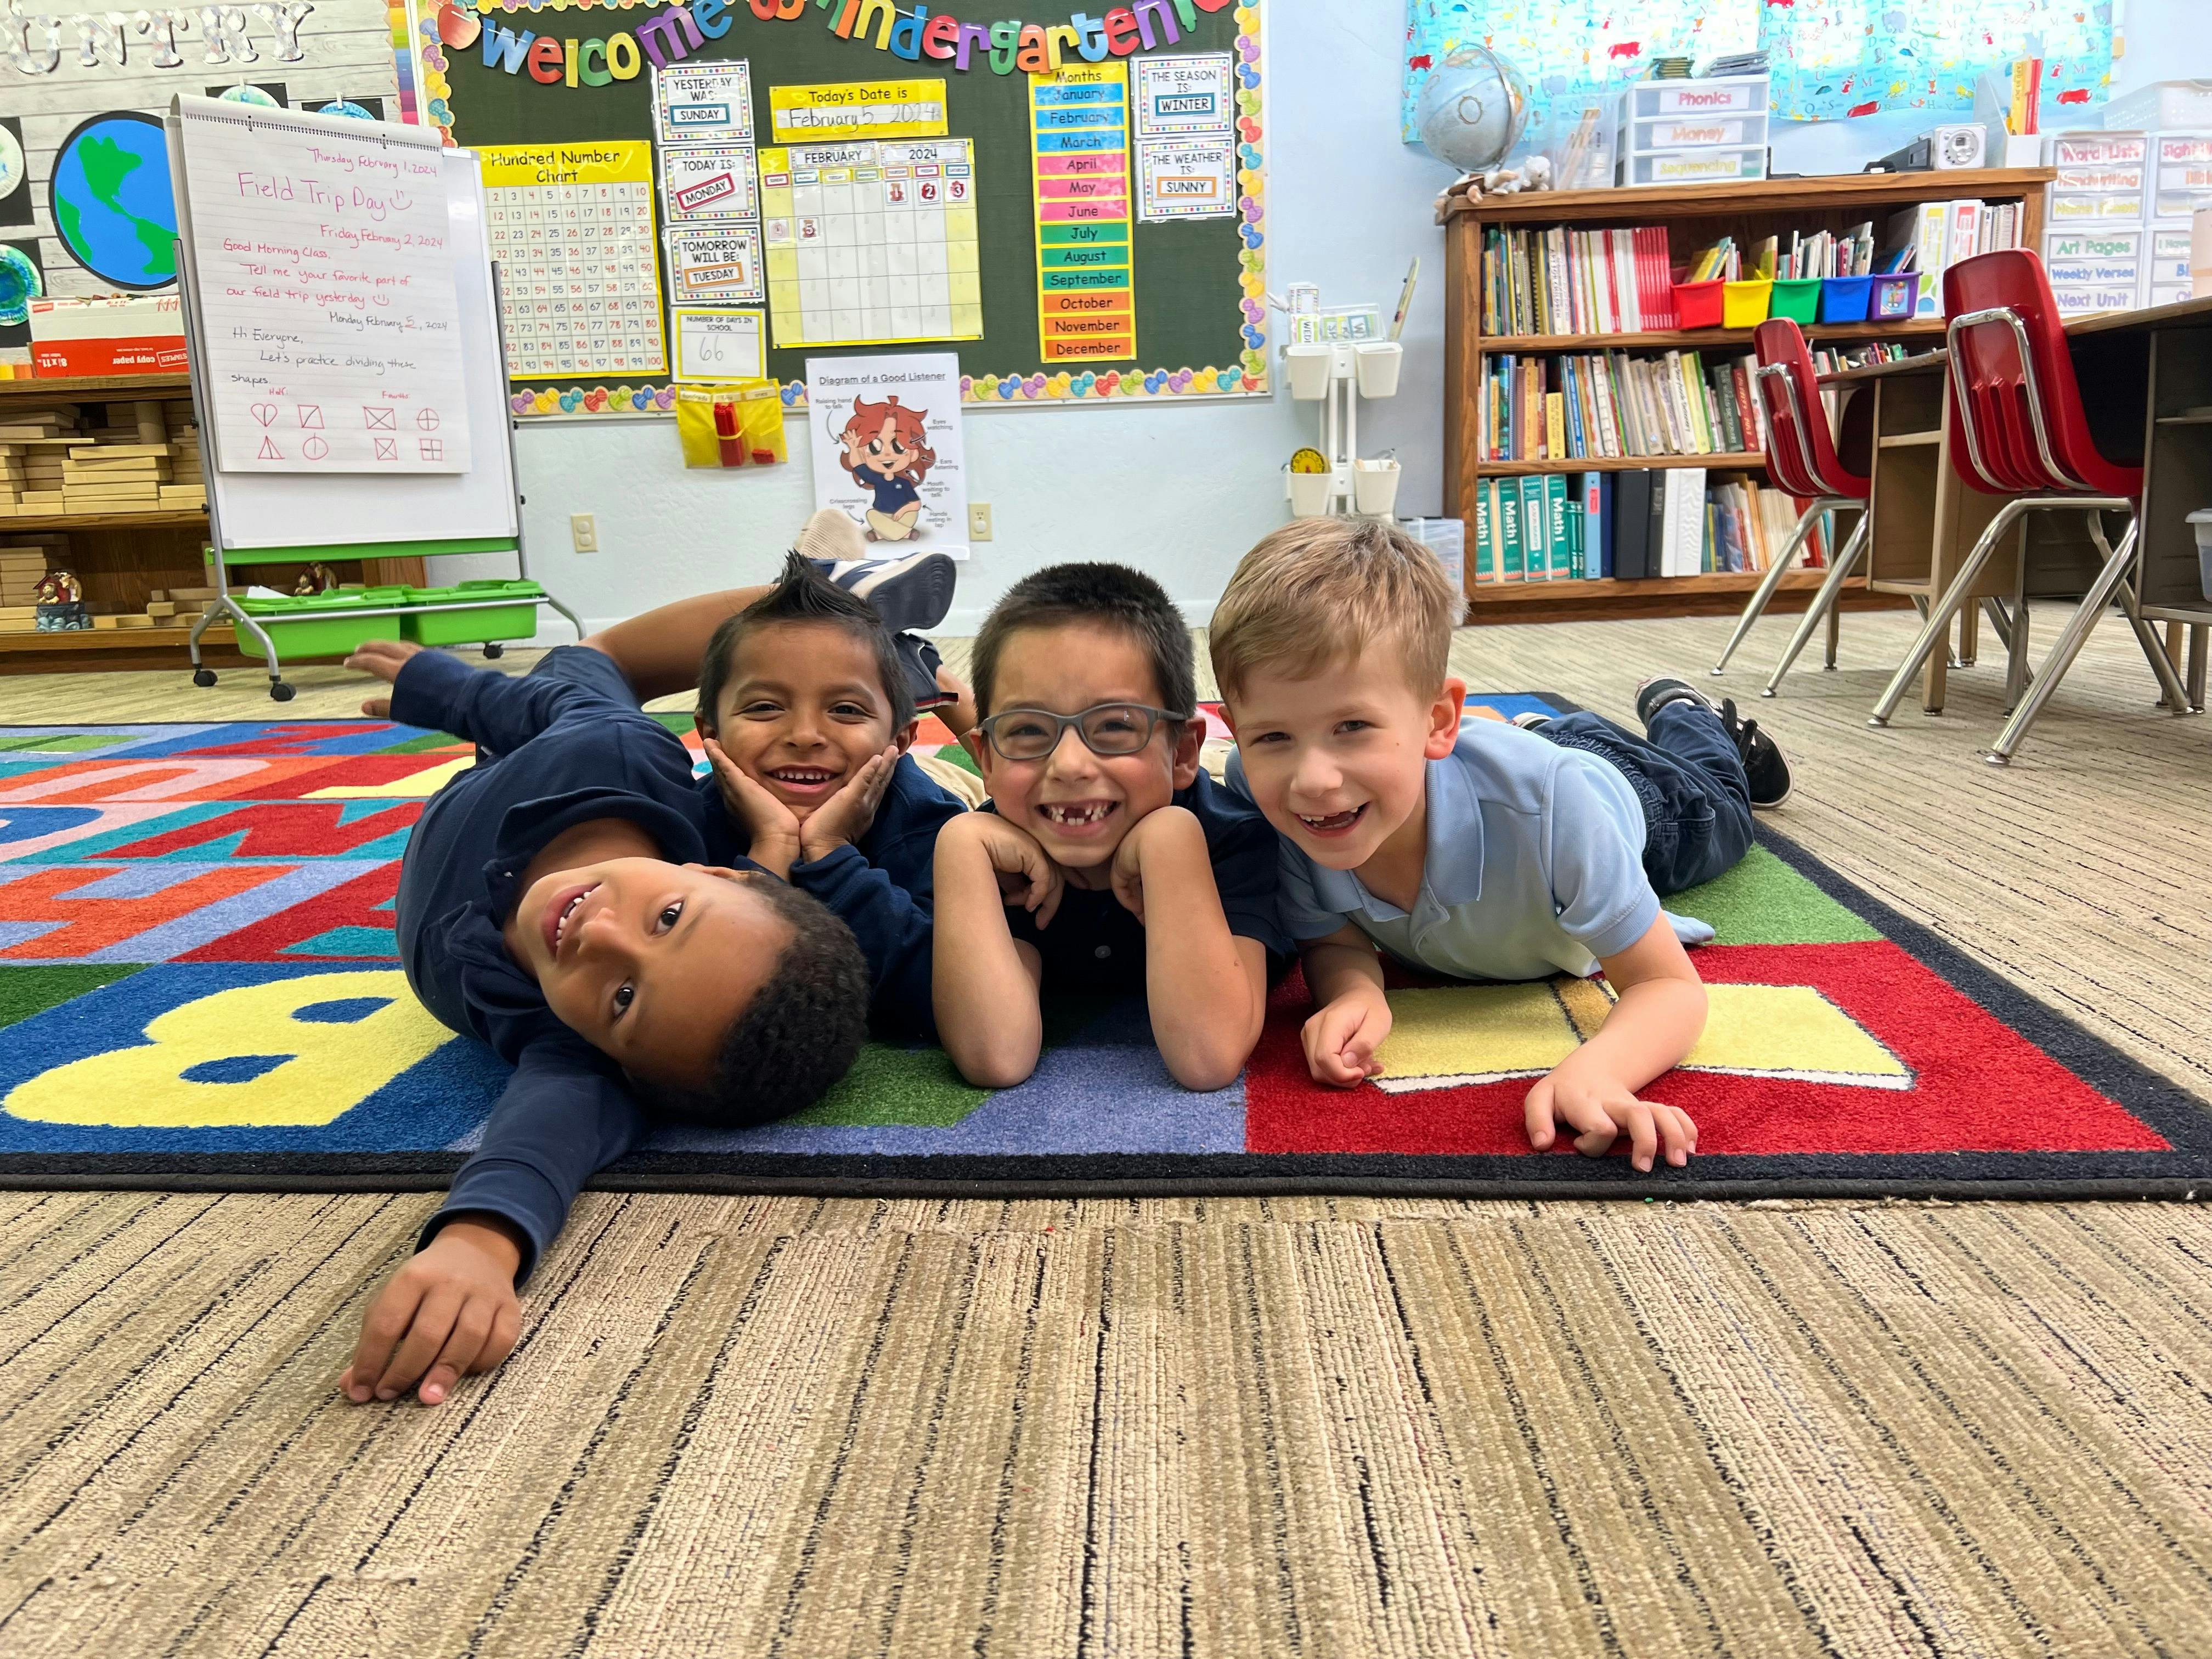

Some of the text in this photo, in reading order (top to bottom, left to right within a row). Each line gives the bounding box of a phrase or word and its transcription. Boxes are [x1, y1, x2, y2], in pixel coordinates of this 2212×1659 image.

[0, 0, 314, 75] UNTRY
[482, 0, 732, 89] welcome
[1055, 70, 1102, 82] Months
[1152, 70, 1216, 82] THE SEASON
[674, 78, 732, 89] YESTERDAY
[1177, 83, 1192, 93] IS:
[809, 87, 907, 105] Today's Date is
[1054, 89, 1105, 101] January
[1679, 91, 1731, 105] Phonics
[1162, 99, 1208, 111] WINTER
[680, 110, 719, 120] SUNDAY
[789, 108, 859, 132] February
[890, 103, 938, 123] 2024
[1050, 111, 1109, 123] February
[1672, 127, 1725, 142] Money
[1061, 137, 1102, 148] March
[492, 150, 620, 166] Hundred Number
[805, 150, 862, 163] FEBRUARY
[909, 149, 938, 160] 2024
[1153, 153, 1222, 165] THE WEATHER
[2062, 148, 2100, 162] Word
[307, 148, 354, 172] Thursday
[359, 155, 398, 178] February
[413, 164, 437, 177] 2024
[682, 160, 736, 171] TODAY IS:
[1066, 158, 1097, 172] April
[1181, 166, 1195, 174] IS:
[1660, 160, 1736, 176] Sequencing
[537, 170, 578, 182] Chart
[686, 180, 726, 204] MONDAY
[925, 185, 933, 198] 2
[954, 184, 962, 197] 3
[1070, 182, 1096, 194] May
[1167, 182, 1206, 193] SUNNY
[238, 172, 386, 221] Field Trip Day
[602, 208, 611, 216] 18
[1068, 206, 1098, 217] June
[805, 224, 814, 234] 5
[1071, 227, 1098, 241] July
[320, 224, 359, 249] Friday
[361, 229, 401, 250] February
[419, 236, 442, 249] 2024
[223, 238, 251, 252] Good
[258, 243, 299, 263] Morning
[682, 240, 747, 252] TOMORROW
[2057, 240, 2130, 255] Art Pages
[692, 252, 740, 262] WILL BE:
[1064, 251, 1107, 265] August
[240, 263, 411, 286] Tell me your favorite part of
[693, 269, 734, 283] TUESDAY
[1051, 274, 1122, 287] September
[2052, 268, 2134, 280] Weekly Verses
[227, 286, 365, 309] our field trip yesterday
[1060, 297, 1113, 309] October
[2057, 292, 2128, 306] Next Unit
[329, 311, 363, 331] Monday
[366, 315, 404, 332] February
[426, 321, 448, 330] 2024
[1056, 320, 1120, 332] November
[233, 327, 303, 349] Hi Everyone,
[699, 335, 724, 361] 66
[1057, 343, 1120, 355] December
[112, 356, 134, 364] paper
[260, 350, 416, 375] Let's practice dividing these
[820, 376, 858, 386] Diagram
[862, 375, 870, 383] of
[881, 373, 905, 382] Good
[1476, 502, 1488, 539] Math
[1505, 500, 1517, 538] Math
[1553, 498, 1564, 535] Math
